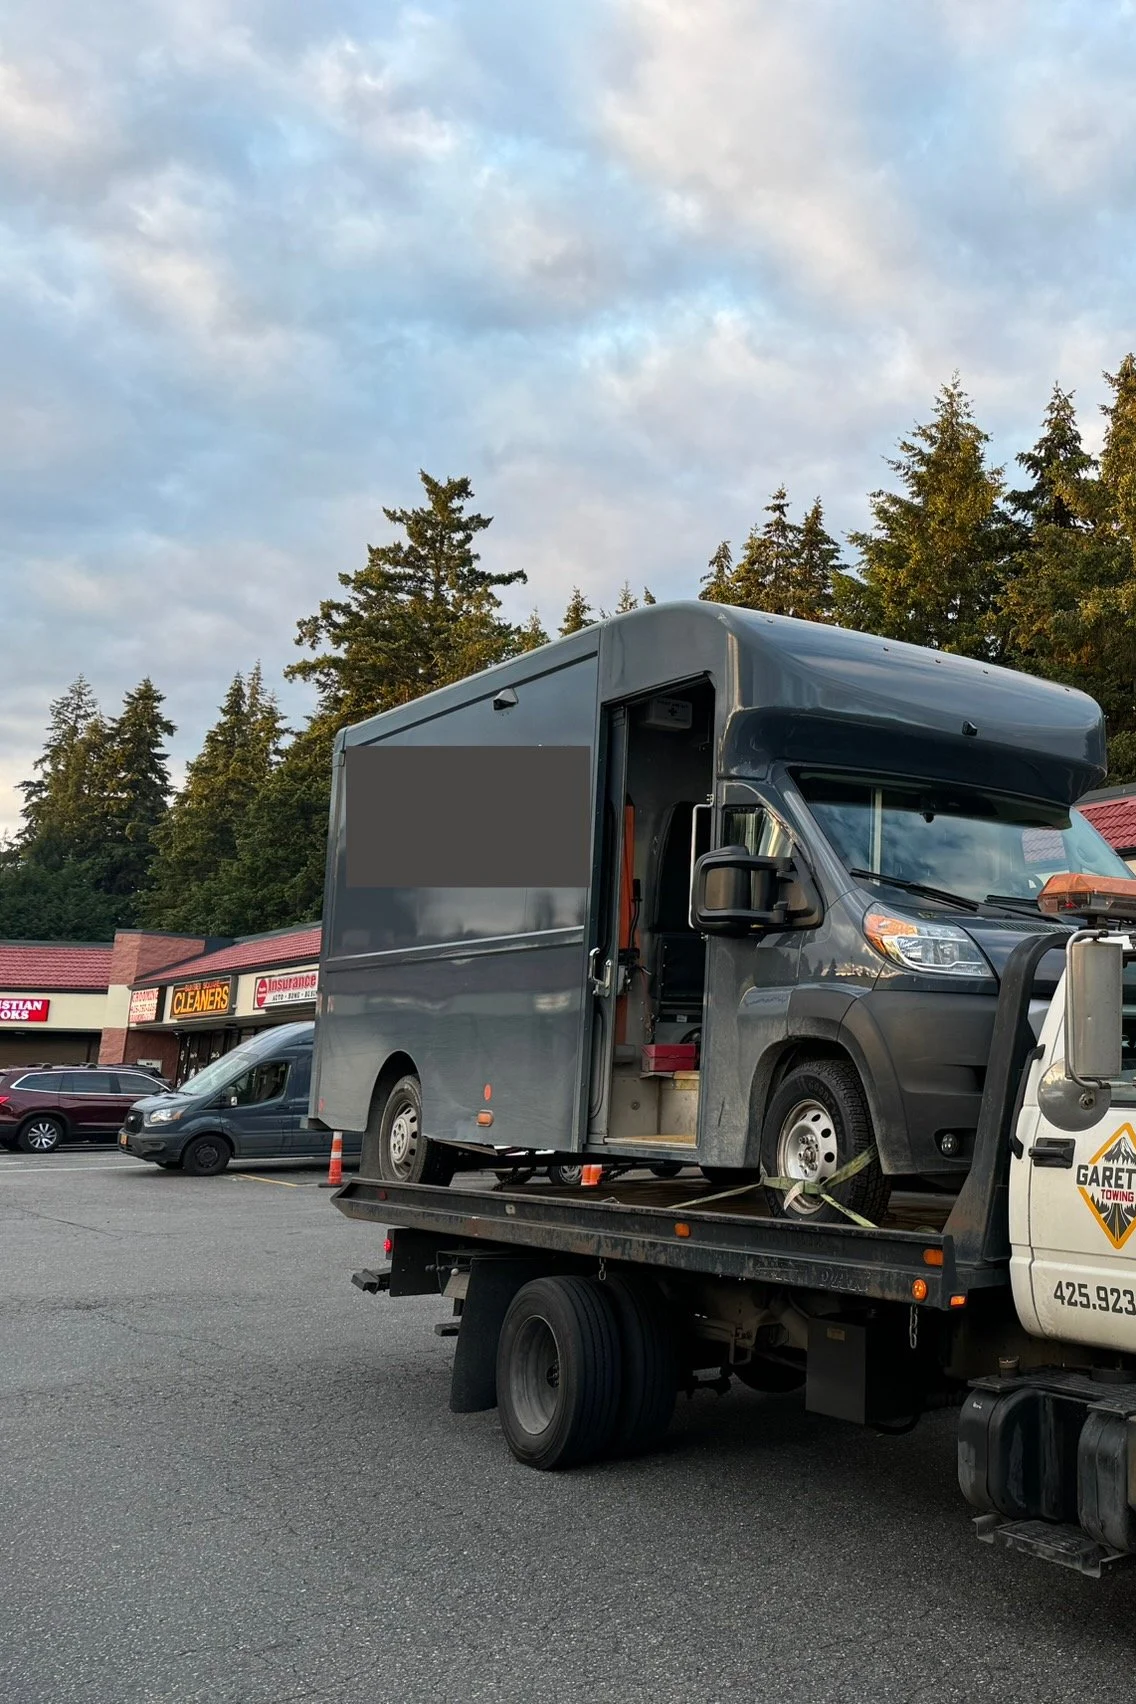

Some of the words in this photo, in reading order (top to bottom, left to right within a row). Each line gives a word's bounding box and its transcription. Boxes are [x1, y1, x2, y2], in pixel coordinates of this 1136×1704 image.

[268, 974, 317, 992] Insurance
[0, 1000, 43, 1010] STIAN
[174, 985, 229, 1014] CLEANERS
[0, 1009, 30, 1020] OKS
[1101, 1189, 1135, 1202] TOWING
